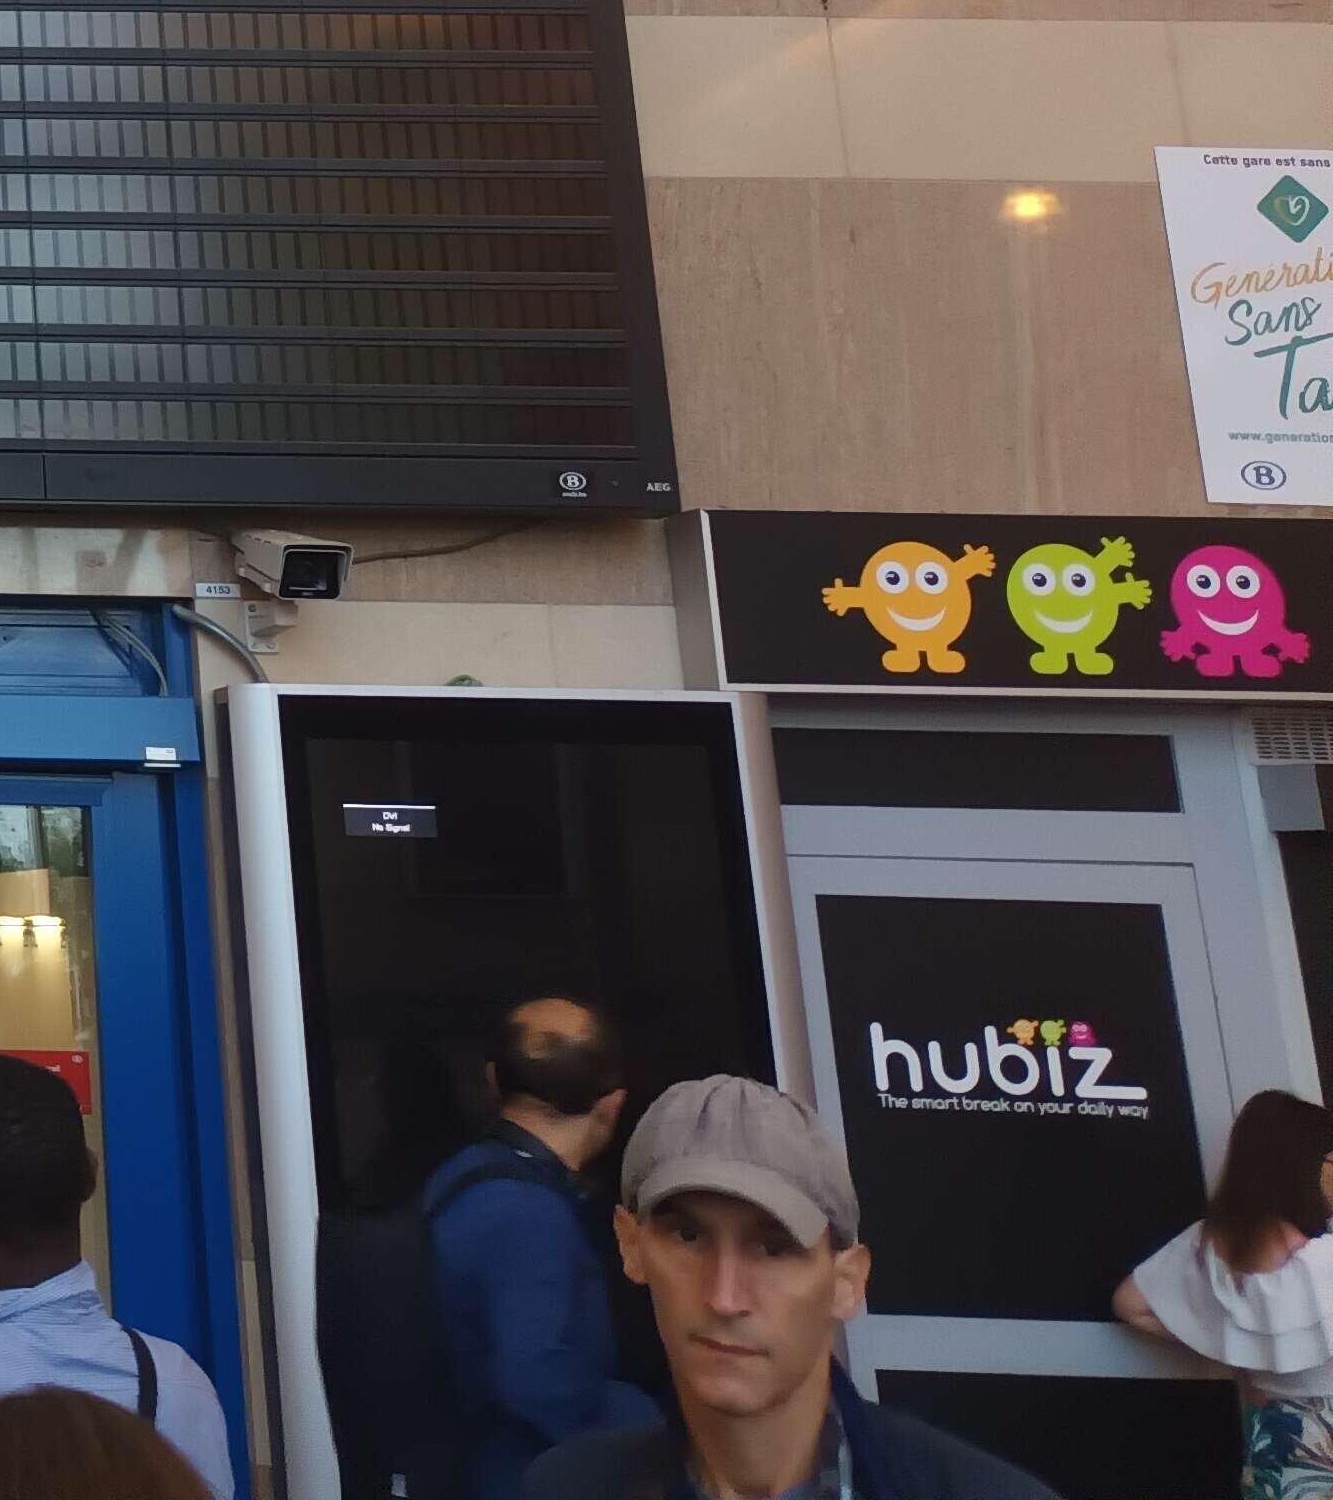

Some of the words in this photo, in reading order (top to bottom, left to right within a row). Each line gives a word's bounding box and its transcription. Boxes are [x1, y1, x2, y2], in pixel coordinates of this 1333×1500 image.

[1203, 154, 1238, 166] Cette
[1243, 156, 1271, 168] gare
[1275, 156, 1296, 167] est
[1300, 157, 1331, 168] sans
[1225, 296, 1322, 346] Sans
[646, 482, 671, 492] AEG
[870, 1021, 1148, 1100] hubiz
[877, 1094, 908, 1109] The
[911, 1096, 960, 1111] smart
[962, 1098, 1011, 1113] break
[1013, 1102, 1035, 1113] on
[1037, 1101, 1074, 1116] your
[1077, 1100, 1115, 1118] daily
[1117, 1104, 1149, 1120] way
